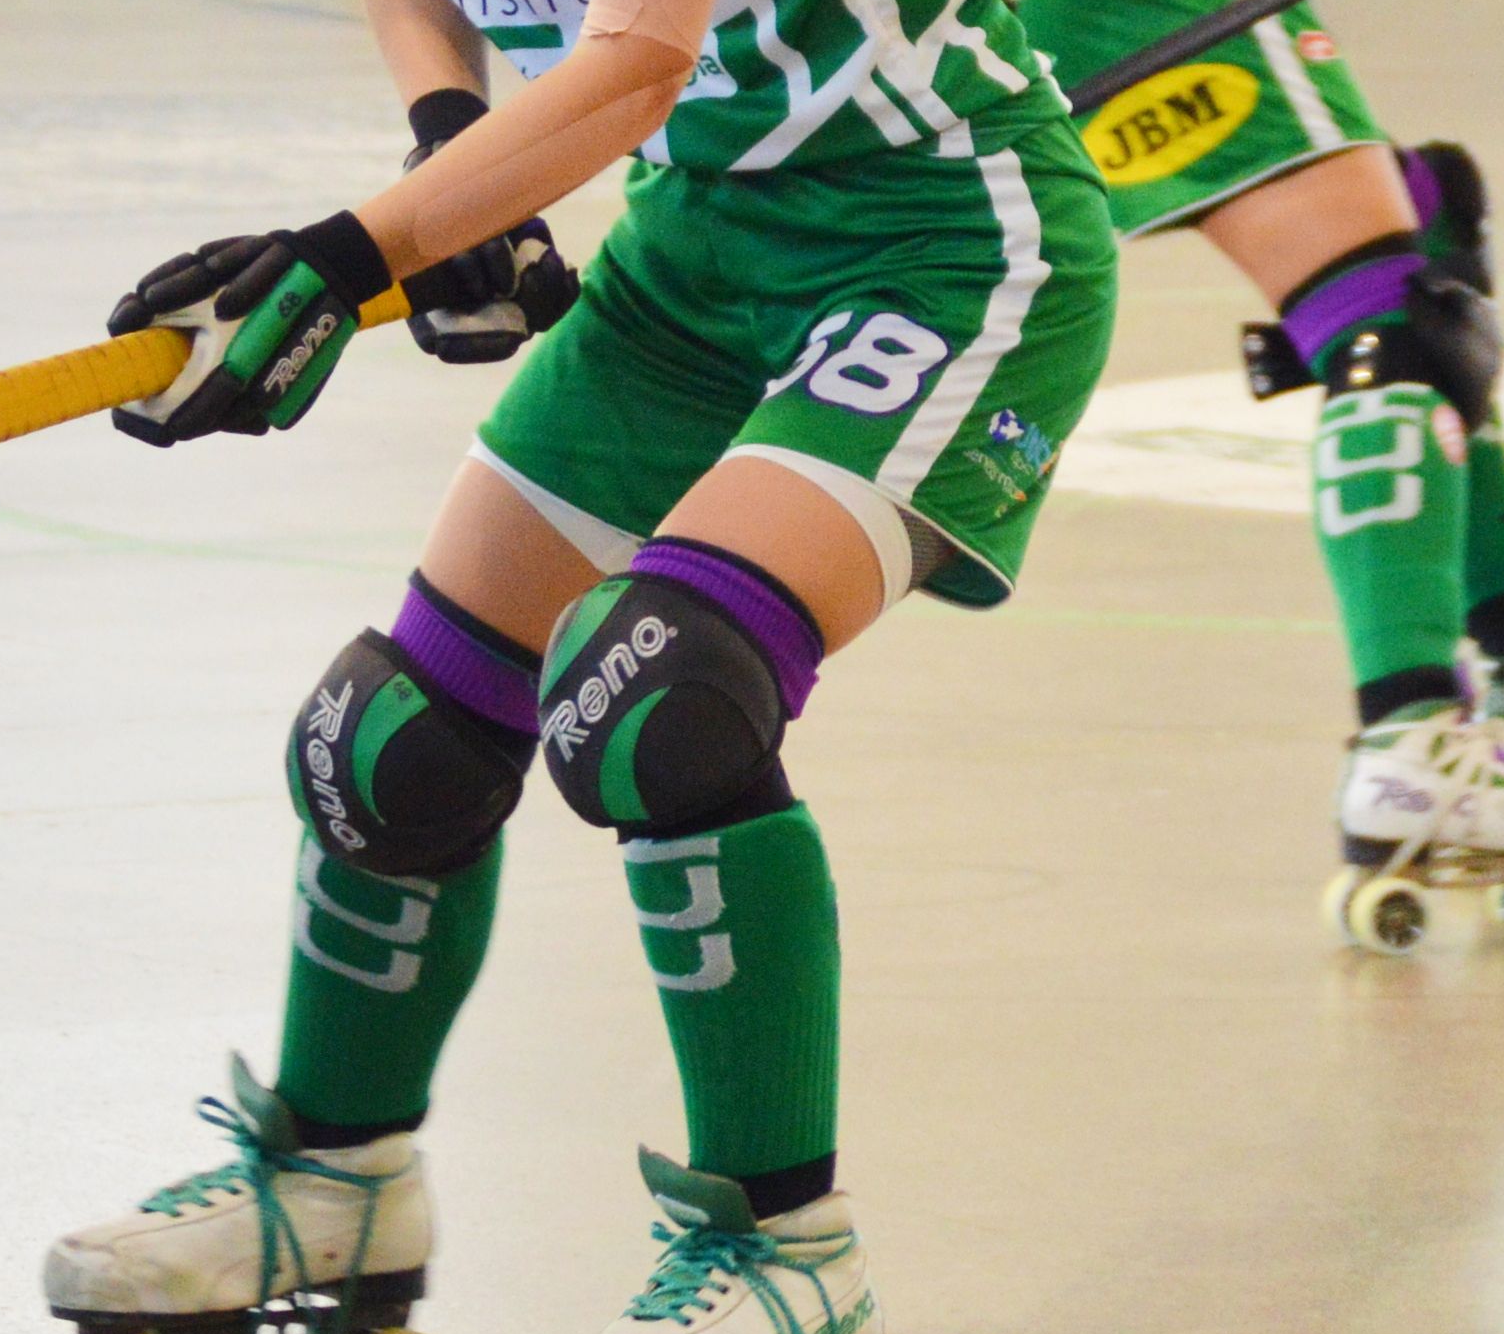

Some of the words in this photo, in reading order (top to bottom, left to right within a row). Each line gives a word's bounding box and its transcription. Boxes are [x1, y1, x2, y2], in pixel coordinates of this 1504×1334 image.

[262, 312, 338, 396] Reno
[542, 613, 669, 764] Reno
[300, 678, 368, 854] Reno
